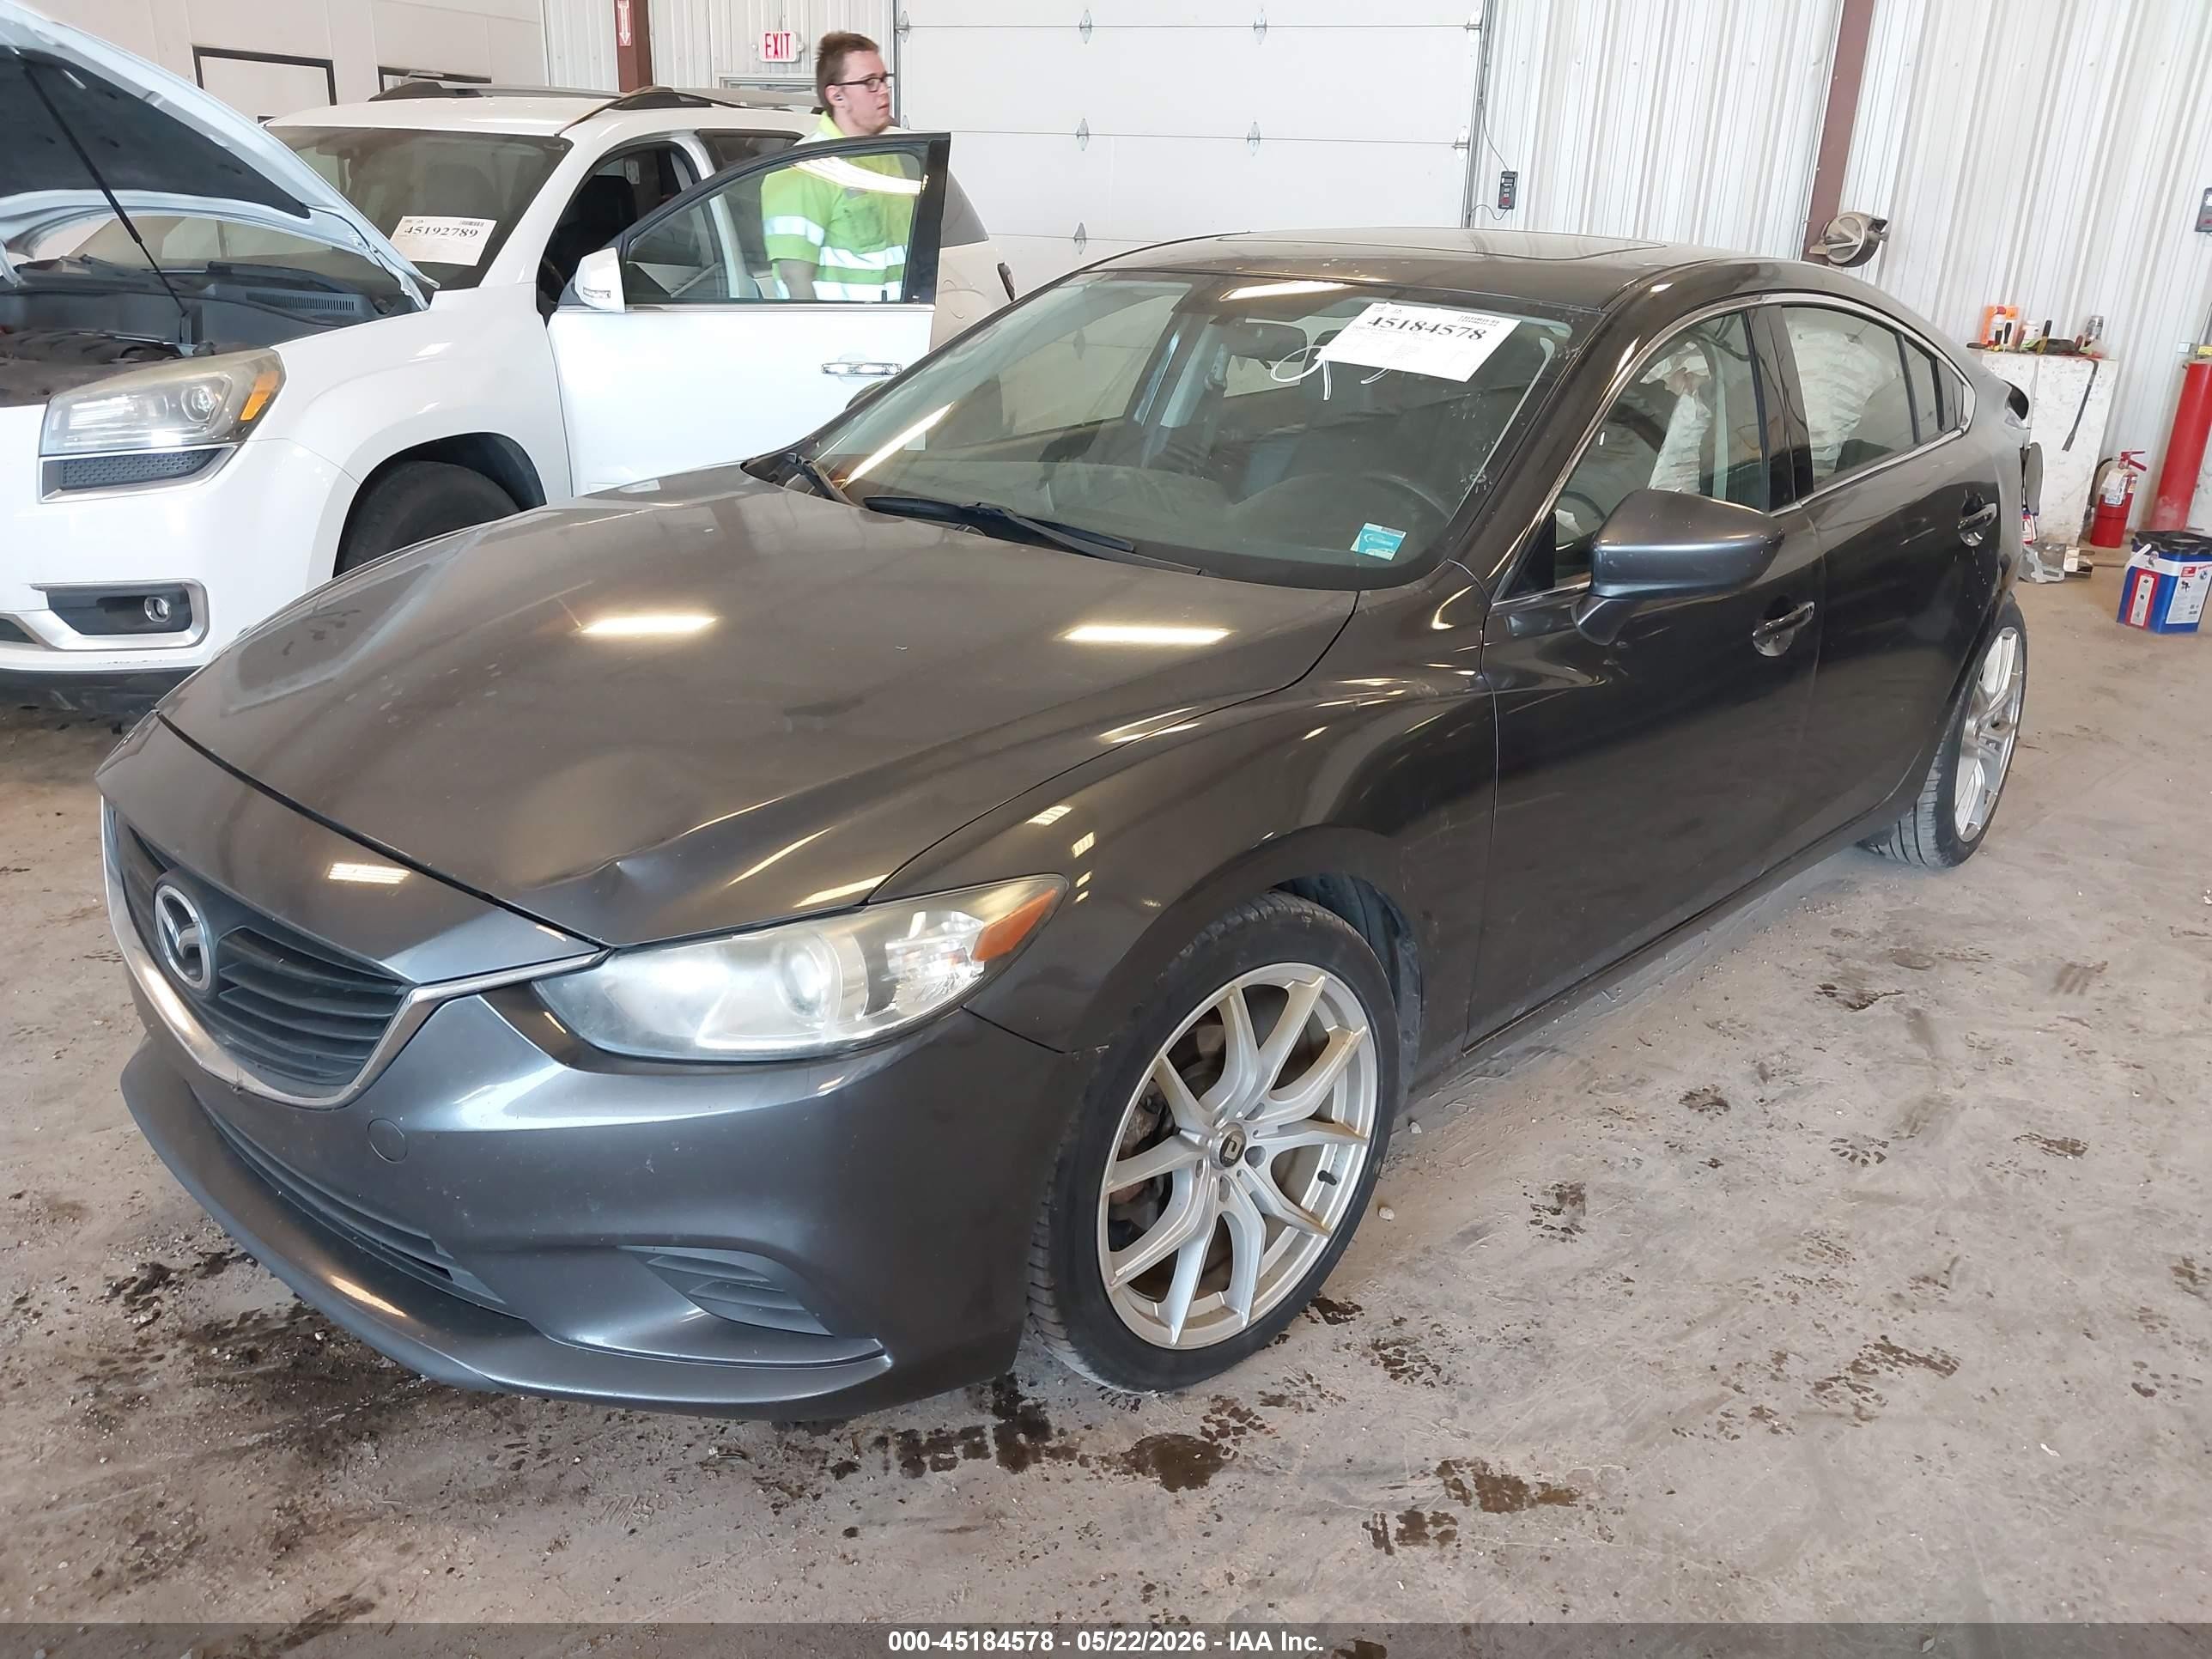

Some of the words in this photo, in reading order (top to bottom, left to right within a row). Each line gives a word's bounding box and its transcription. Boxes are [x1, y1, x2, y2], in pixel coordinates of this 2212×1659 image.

[765, 33, 791, 58] EXIT
[404, 226, 478, 238] 45192789
[1367, 316, 1487, 340] 45184578
